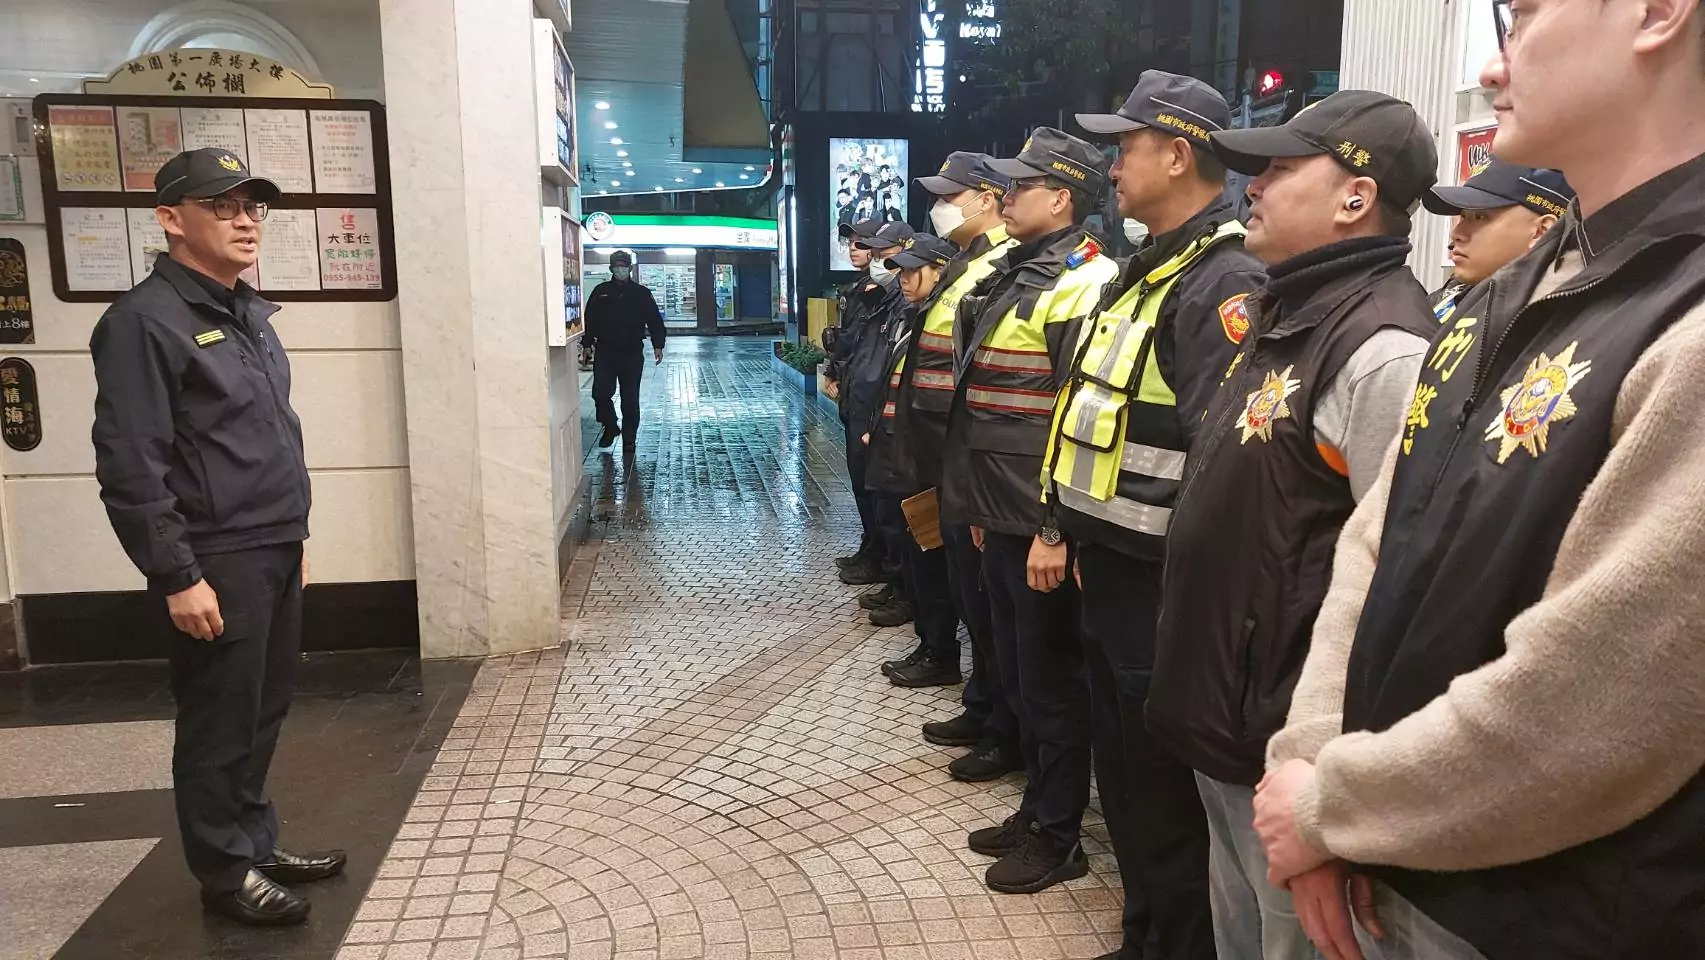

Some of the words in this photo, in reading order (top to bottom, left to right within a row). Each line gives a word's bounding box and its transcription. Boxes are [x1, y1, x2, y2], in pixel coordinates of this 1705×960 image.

[128, 51, 284, 81] 桃園第一廣場大樓
[167, 71, 245, 94] 公佈欄
[1336, 140, 1371, 167] 刑警
[327, 232, 372, 245] 大車位
[5, 426, 28, 436] KTV
